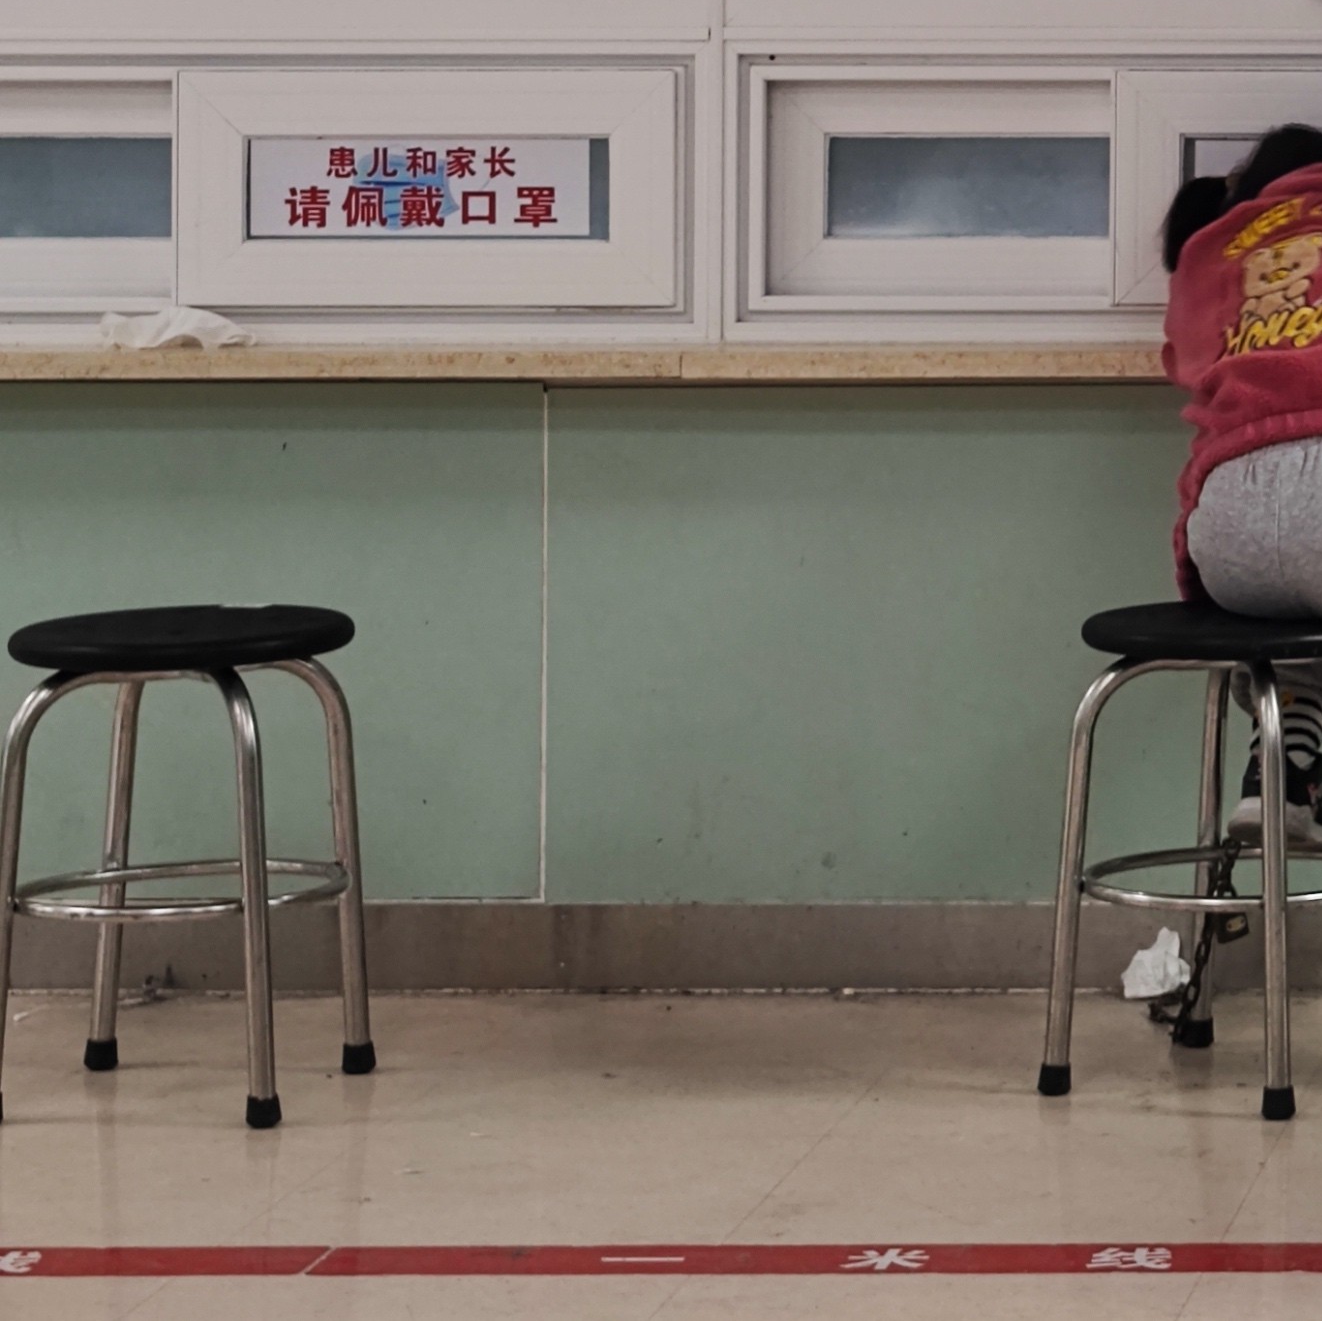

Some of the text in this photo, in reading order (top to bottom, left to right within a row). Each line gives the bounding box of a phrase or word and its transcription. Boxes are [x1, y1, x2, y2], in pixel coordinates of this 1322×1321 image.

[327, 146, 517, 179] 患儿和家长
[284, 186, 559, 228] 请佩戴口罩
